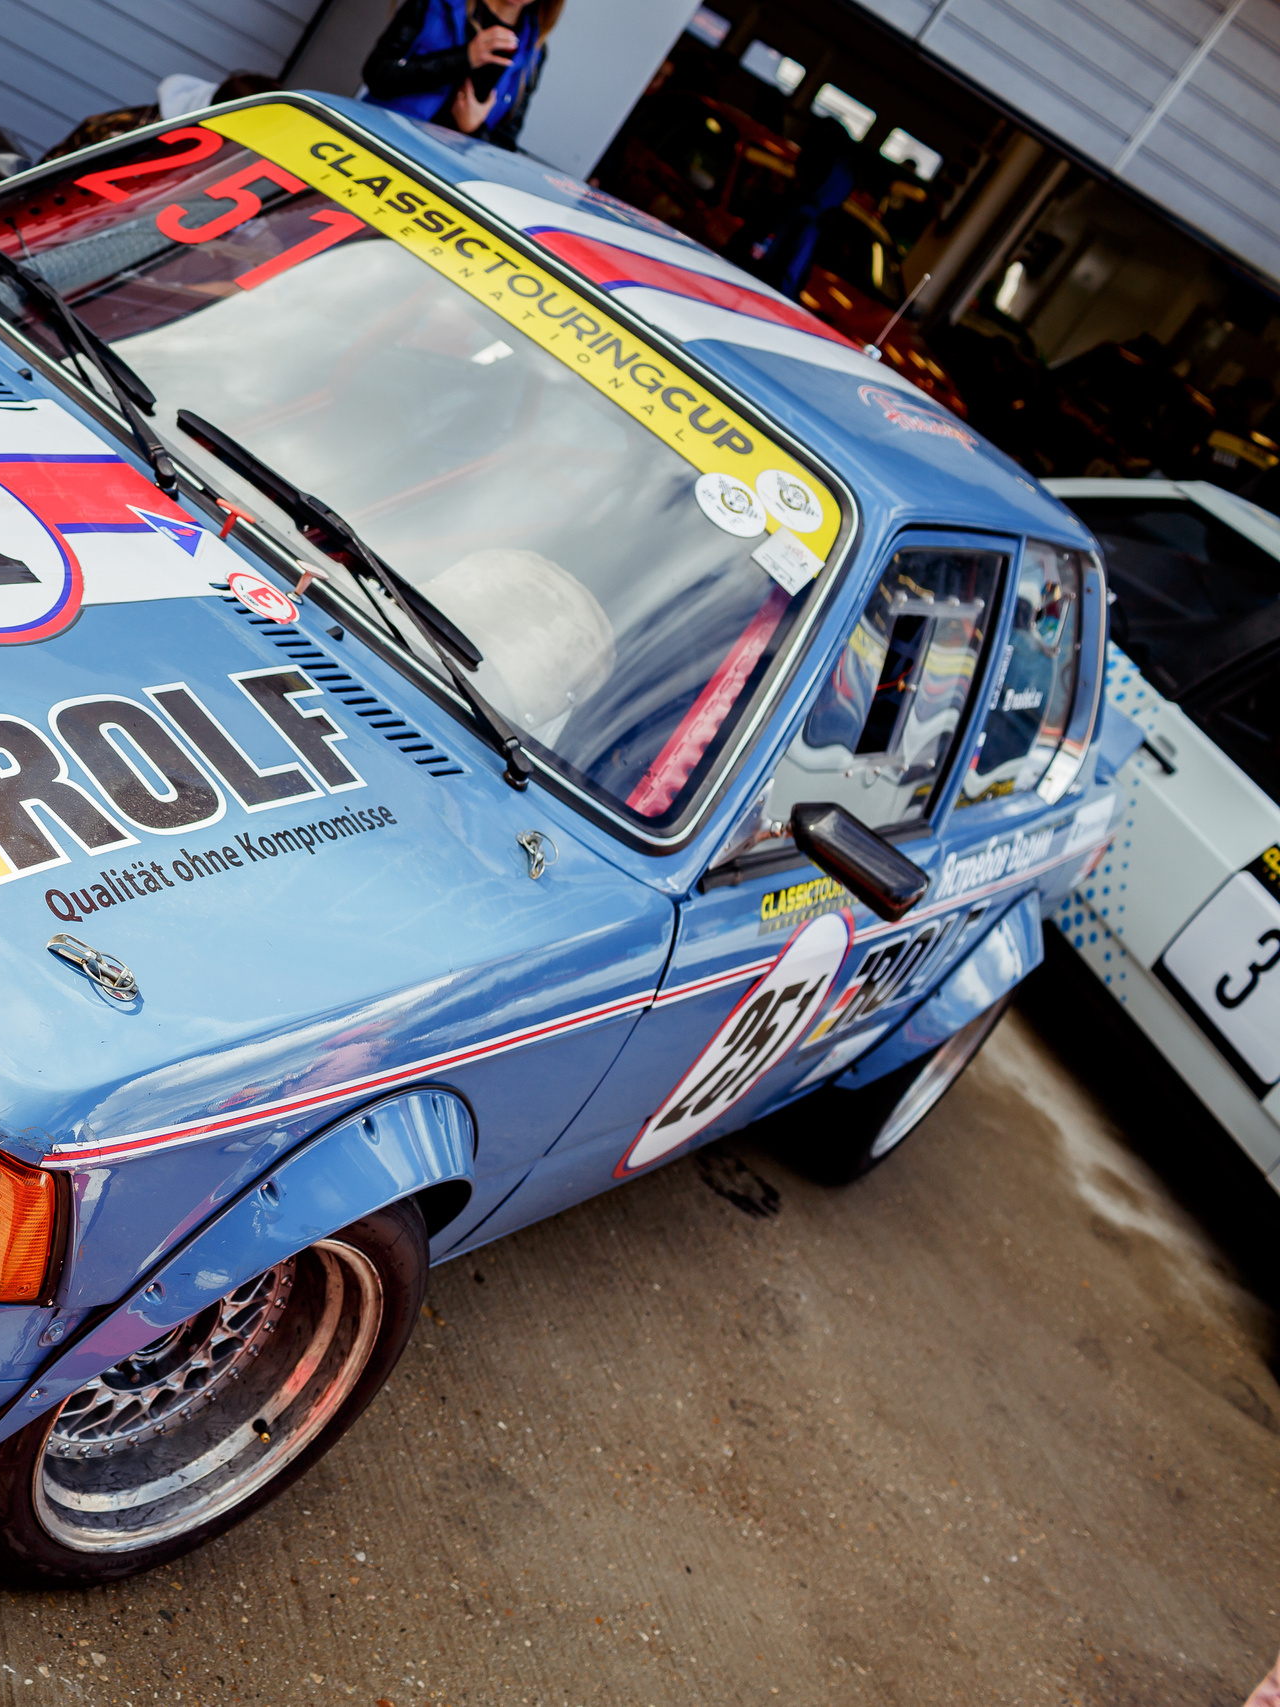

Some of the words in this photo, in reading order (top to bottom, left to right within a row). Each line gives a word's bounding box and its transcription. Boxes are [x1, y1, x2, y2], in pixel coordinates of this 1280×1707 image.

[74, 127, 366, 291] 251
[320, 173, 687, 443] INTERNATIONAL
[45, 860, 176, 923] Qualität
[171, 848, 245, 883] ohne
[234, 805, 398, 863] Kompromisse
[652, 973, 830, 1132] 251
